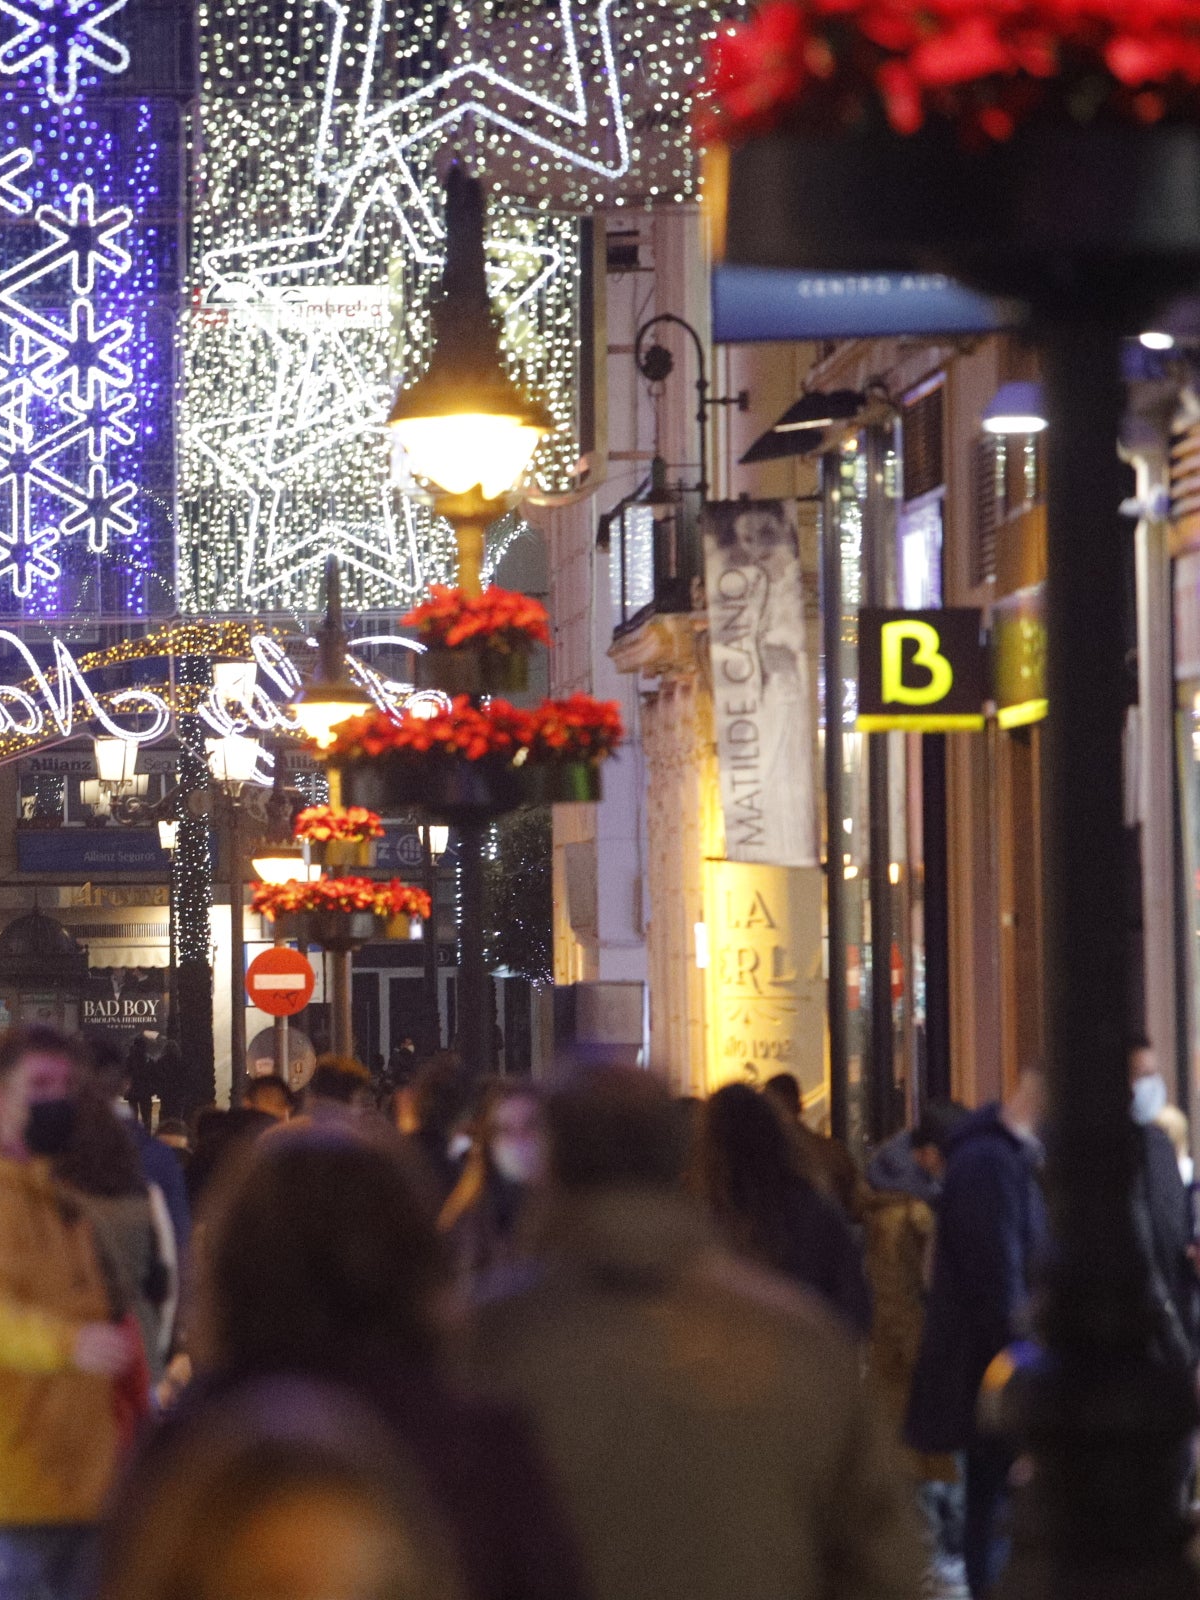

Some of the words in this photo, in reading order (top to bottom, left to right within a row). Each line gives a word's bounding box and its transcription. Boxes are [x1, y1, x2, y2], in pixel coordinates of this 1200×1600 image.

[718, 568, 756, 685] CANO
[881, 619, 954, 706] B
[30, 757, 92, 771] Allianz
[726, 697, 766, 848] MATILDE
[84, 1000, 120, 1016] BAD
[123, 1000, 160, 1016] BOY
